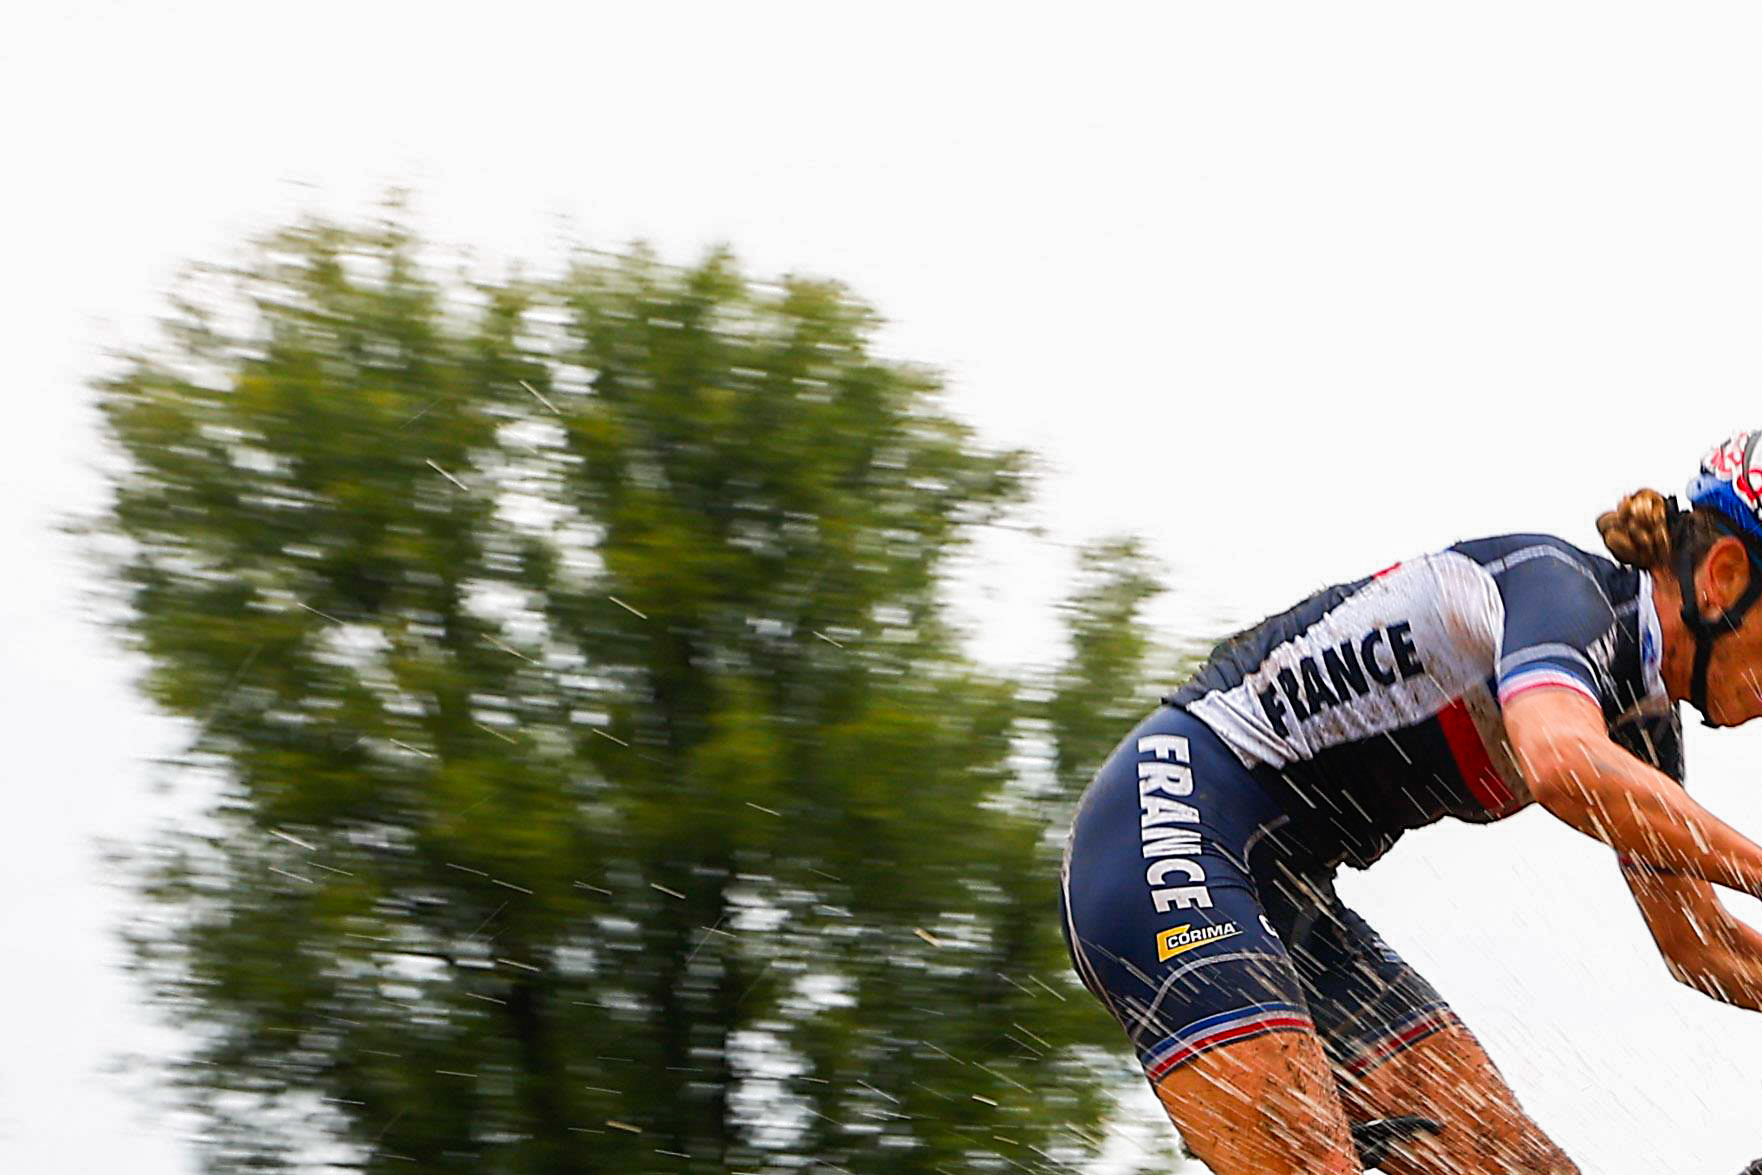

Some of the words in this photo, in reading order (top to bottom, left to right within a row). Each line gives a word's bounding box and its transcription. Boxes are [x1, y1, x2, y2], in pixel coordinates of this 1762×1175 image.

[1258, 620, 1426, 738] FRANCE
[1138, 734, 1214, 913] FRANCE
[1167, 922, 1236, 948] CORIMA
